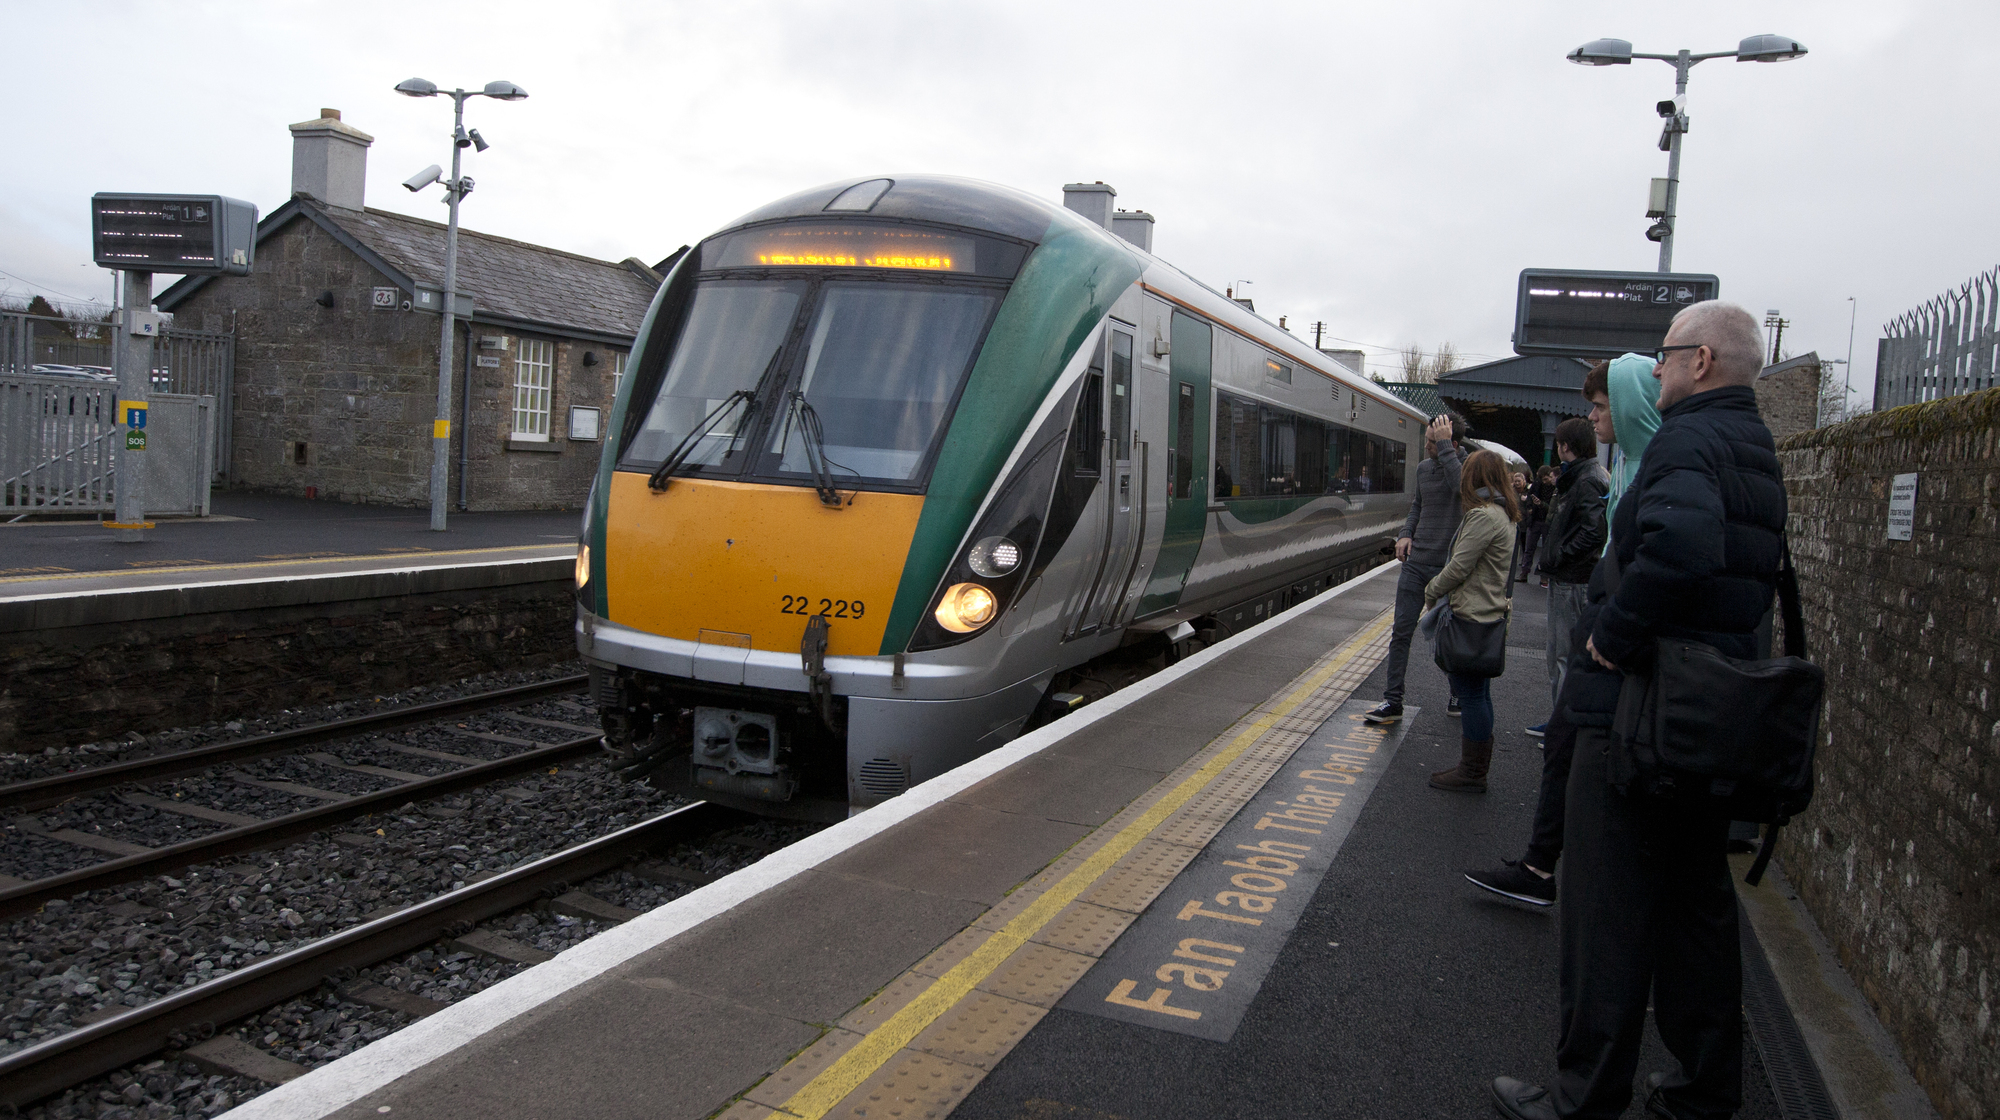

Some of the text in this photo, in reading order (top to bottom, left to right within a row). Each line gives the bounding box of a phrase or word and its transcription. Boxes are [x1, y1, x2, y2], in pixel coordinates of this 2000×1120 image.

[183, 206, 190, 219] 1
[1625, 283, 1652, 291] Ardán
[1655, 286, 1669, 302] 2
[1624, 293, 1643, 302] Plat.
[128, 437, 145, 445] SOS
[781, 595, 865, 619] 22 229
[1298, 753, 1370, 785] Den
[1254, 785, 1346, 835] Thiar
[1176, 840, 1312, 927] Taobh
[1105, 937, 1245, 1020] Fan
